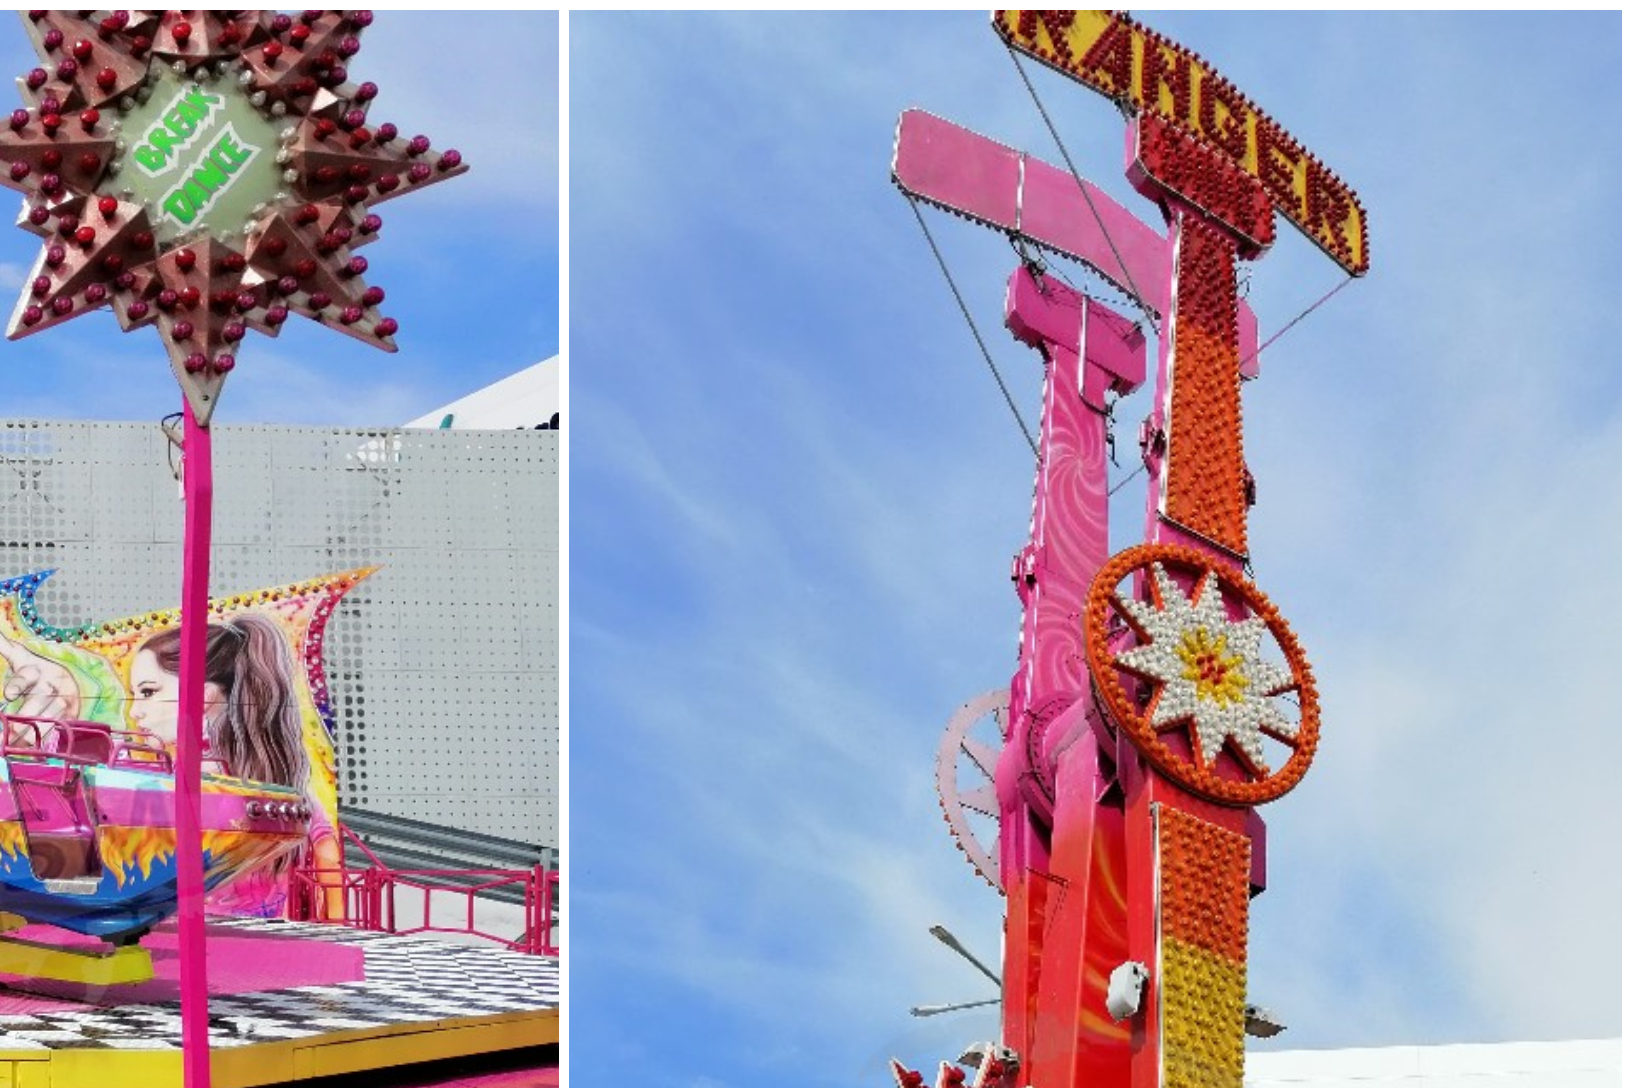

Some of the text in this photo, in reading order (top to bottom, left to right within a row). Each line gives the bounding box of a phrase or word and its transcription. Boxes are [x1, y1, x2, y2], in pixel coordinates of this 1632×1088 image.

[133, 84, 222, 173] BREAK
[161, 128, 254, 225] DANCE
[1016, 10, 1354, 254] RANGER
